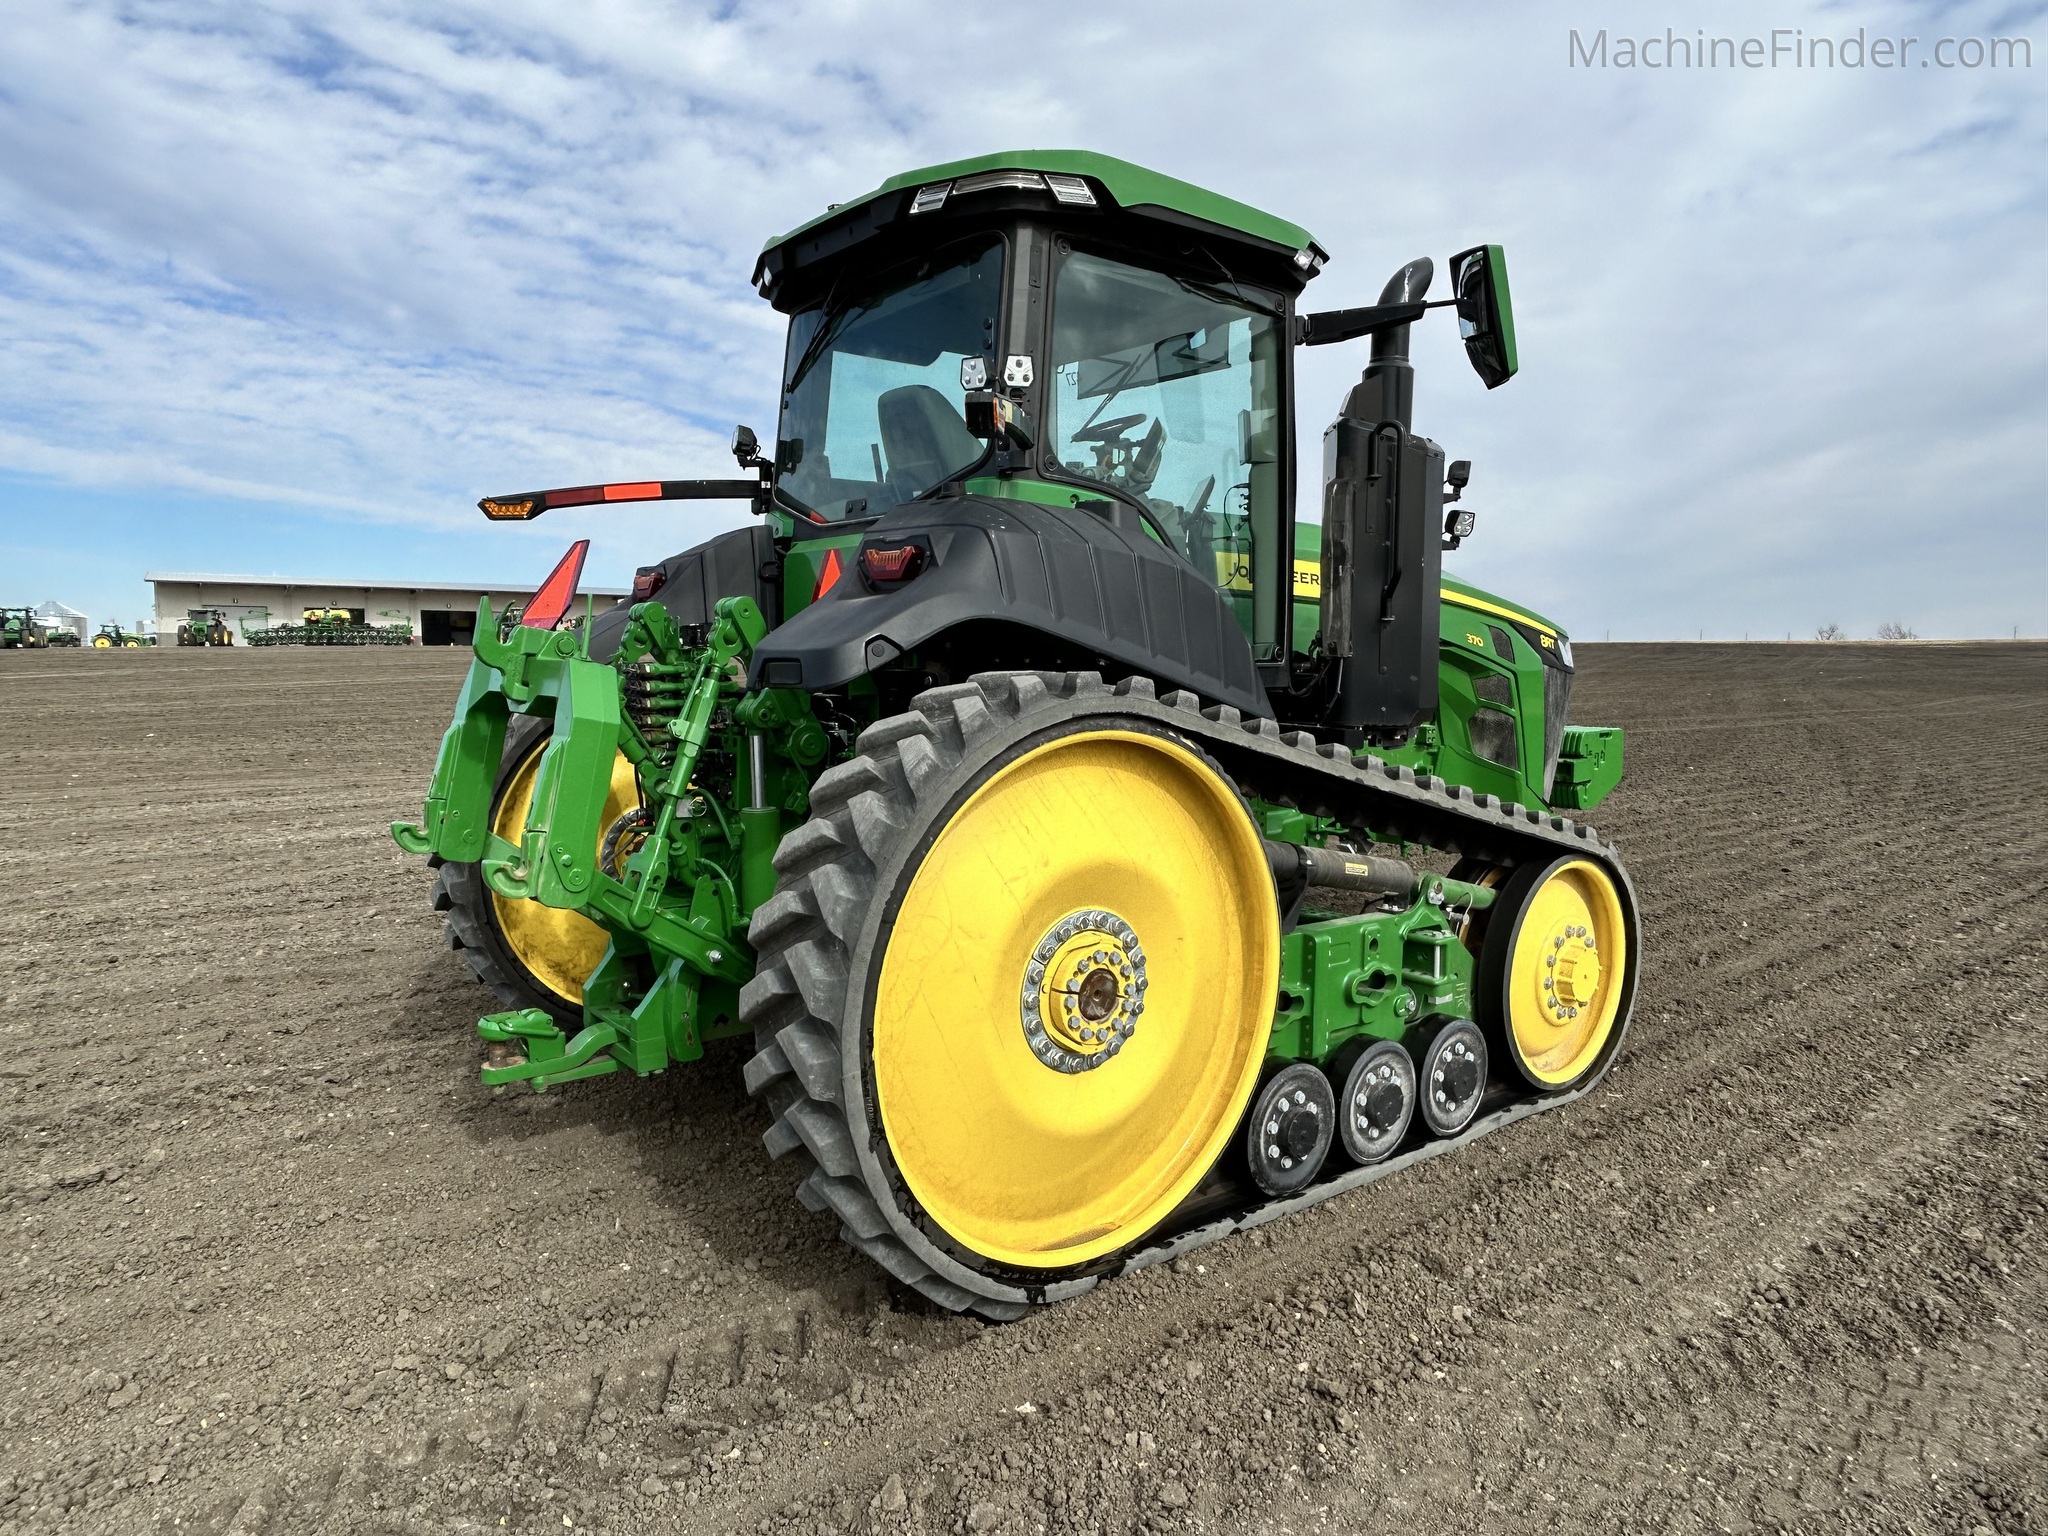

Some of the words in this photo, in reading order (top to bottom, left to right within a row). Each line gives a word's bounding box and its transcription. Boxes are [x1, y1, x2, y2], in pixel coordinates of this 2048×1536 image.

[1293, 571, 1320, 585] EER
[1465, 633, 1484, 647] 370
[1540, 634, 1555, 650] 8RT
